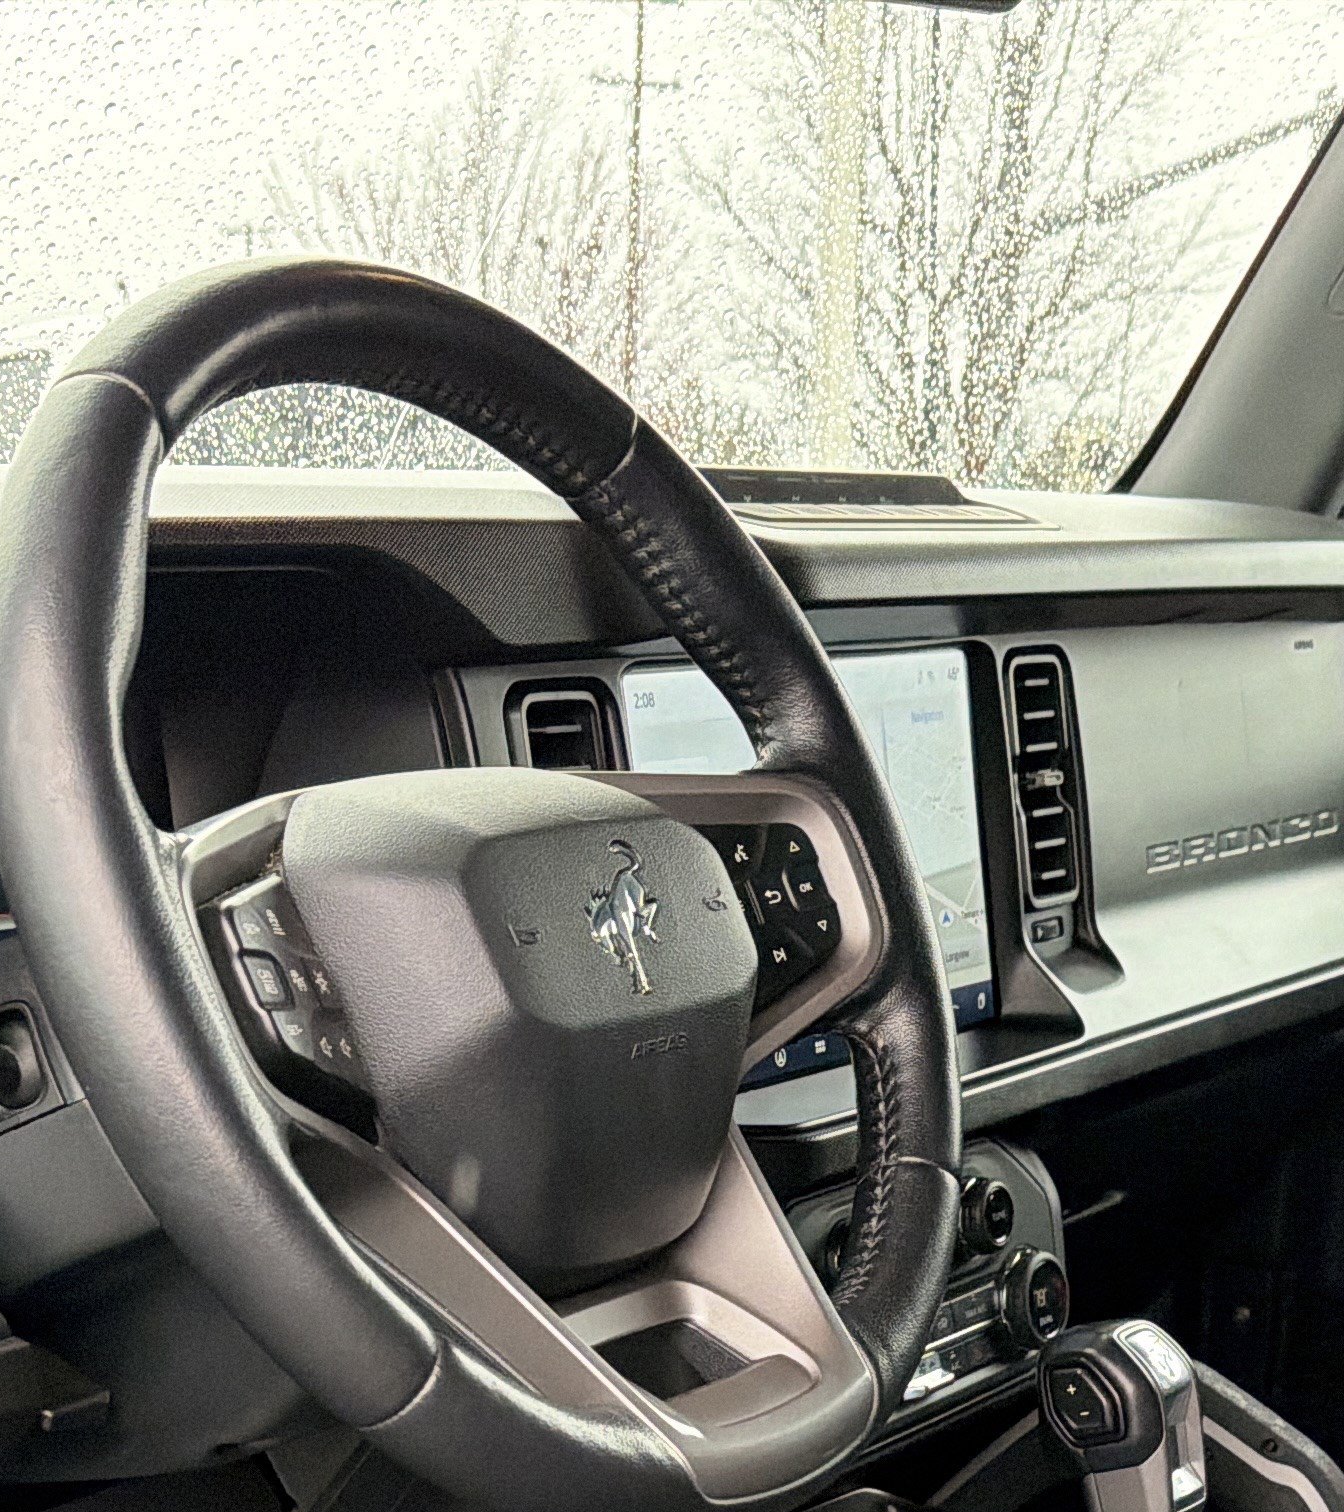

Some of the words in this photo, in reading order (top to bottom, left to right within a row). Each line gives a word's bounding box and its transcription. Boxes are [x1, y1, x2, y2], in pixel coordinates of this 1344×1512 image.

[633, 691, 656, 709] 2:08
[1146, 808, 1339, 874] BRONCO
[799, 881, 814, 893] OK
